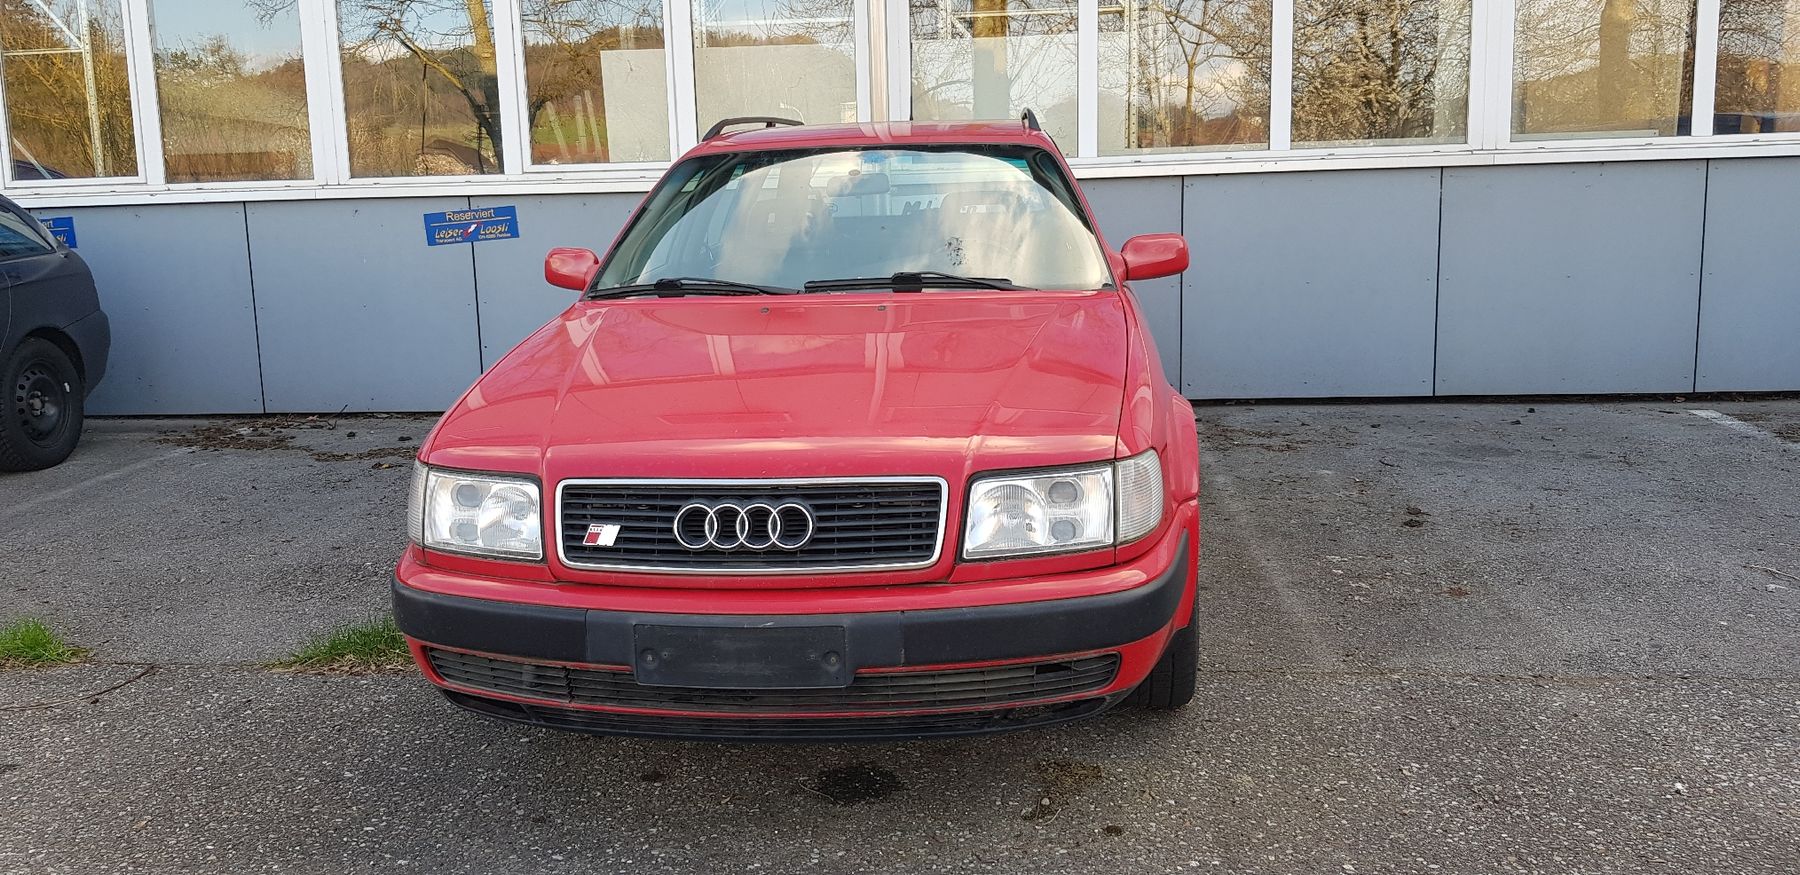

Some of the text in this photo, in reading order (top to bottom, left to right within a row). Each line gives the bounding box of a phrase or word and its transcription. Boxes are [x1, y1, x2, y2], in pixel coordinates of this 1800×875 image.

[446, 209, 495, 221] Reserviert
[435, 222, 510, 239] Leiser Loosli
